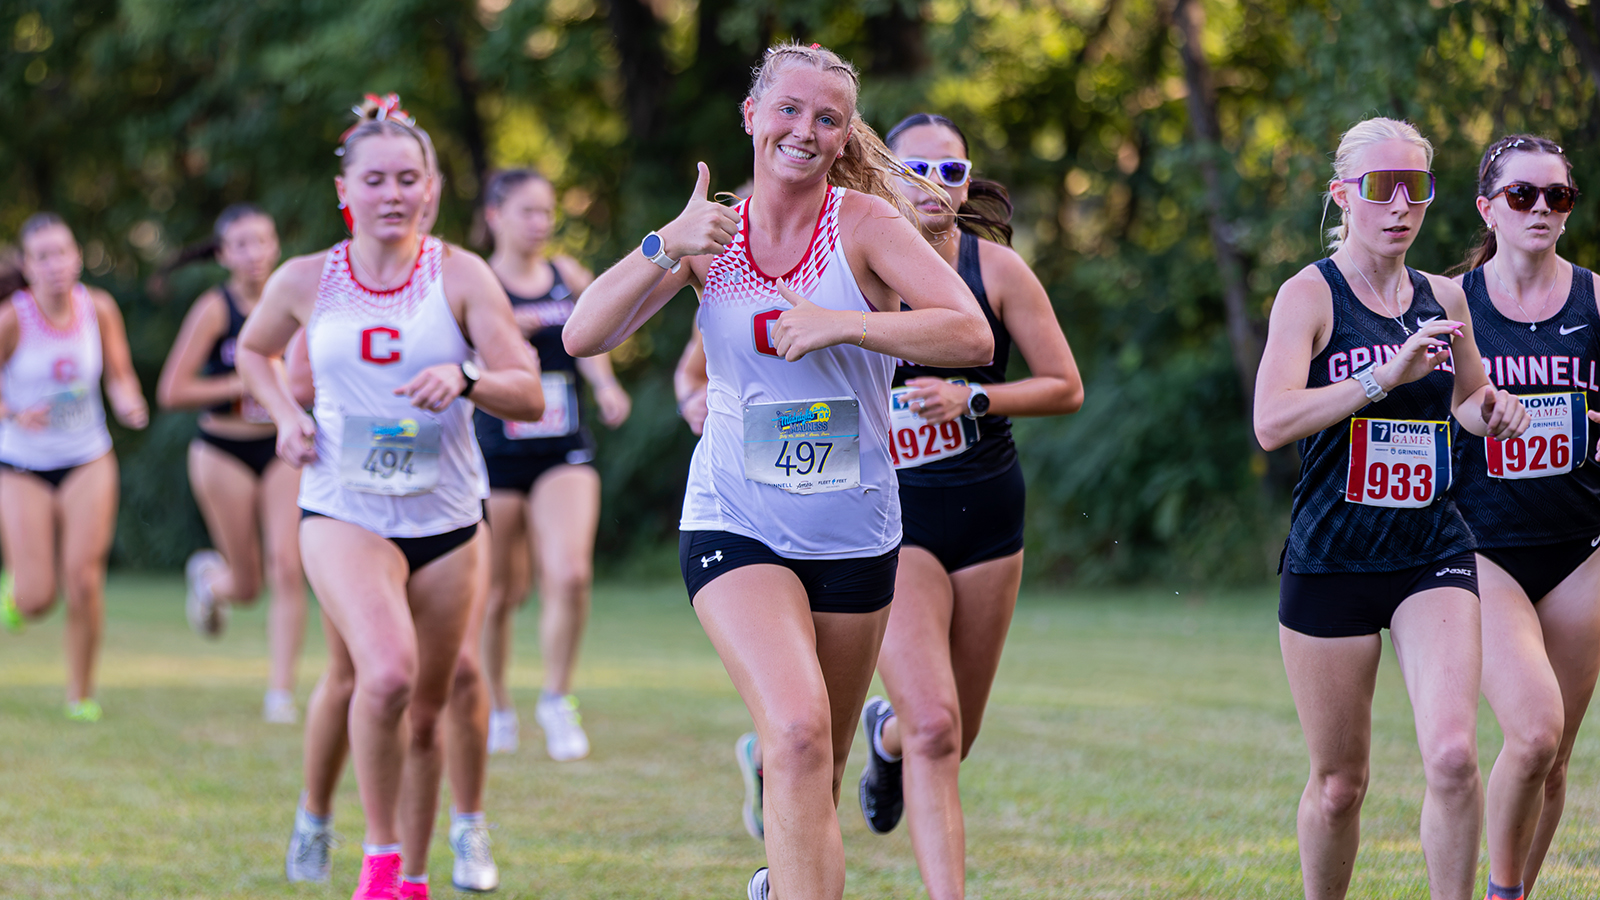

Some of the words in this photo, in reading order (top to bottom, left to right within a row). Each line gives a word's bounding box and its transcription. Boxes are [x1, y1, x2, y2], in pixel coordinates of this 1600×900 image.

[360, 326, 402, 367] C
[1481, 355, 1600, 392] RINNELL
[771, 408, 815, 426] Midnight
[1525, 396, 1567, 409] IOWA
[1526, 407, 1568, 417] GAMES
[897, 420, 962, 460] 929
[1391, 434, 1432, 445] GAMES
[1392, 423, 1431, 435] IOWA
[363, 446, 417, 480] 494
[775, 440, 834, 477] 497
[1504, 433, 1570, 473] 926
[1366, 462, 1433, 501] 933
